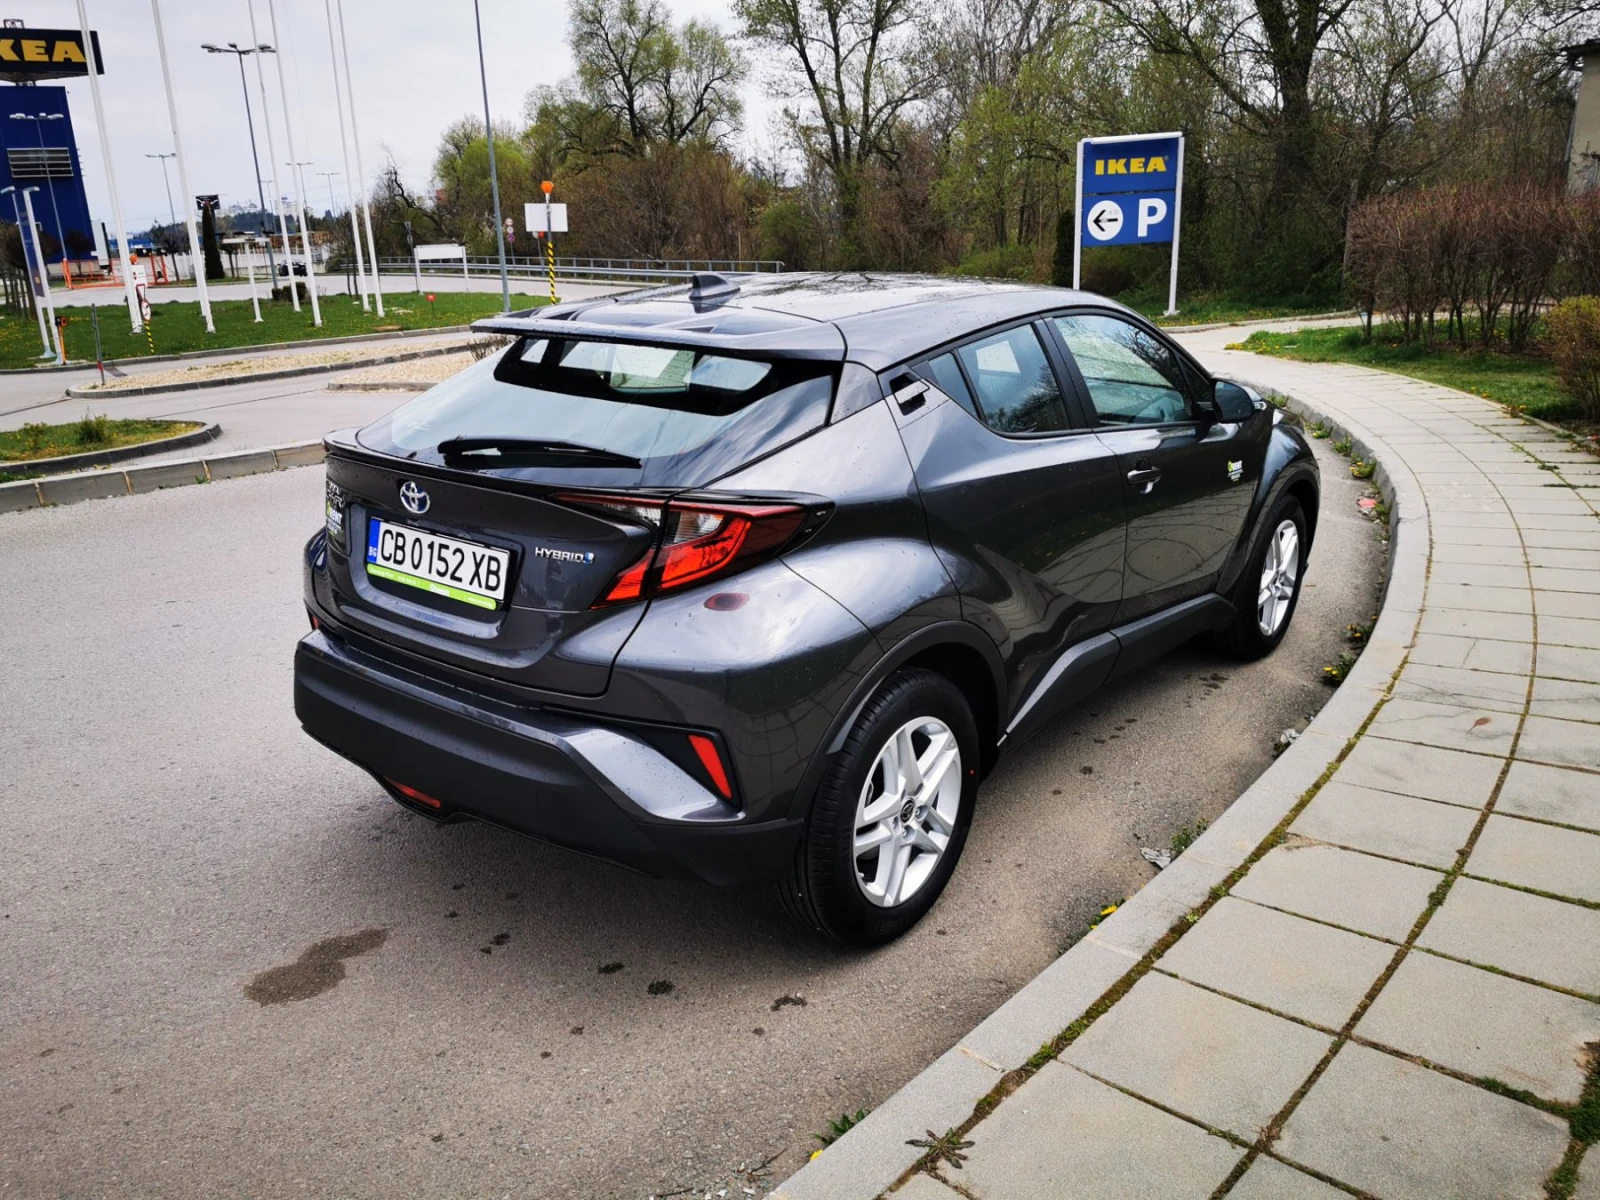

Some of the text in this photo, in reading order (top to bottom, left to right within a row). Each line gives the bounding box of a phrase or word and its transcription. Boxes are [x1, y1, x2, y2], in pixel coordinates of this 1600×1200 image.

[1095, 156, 1167, 175] IKEA
[1137, 198, 1167, 237] P
[535, 547, 584, 563] HYBRID
